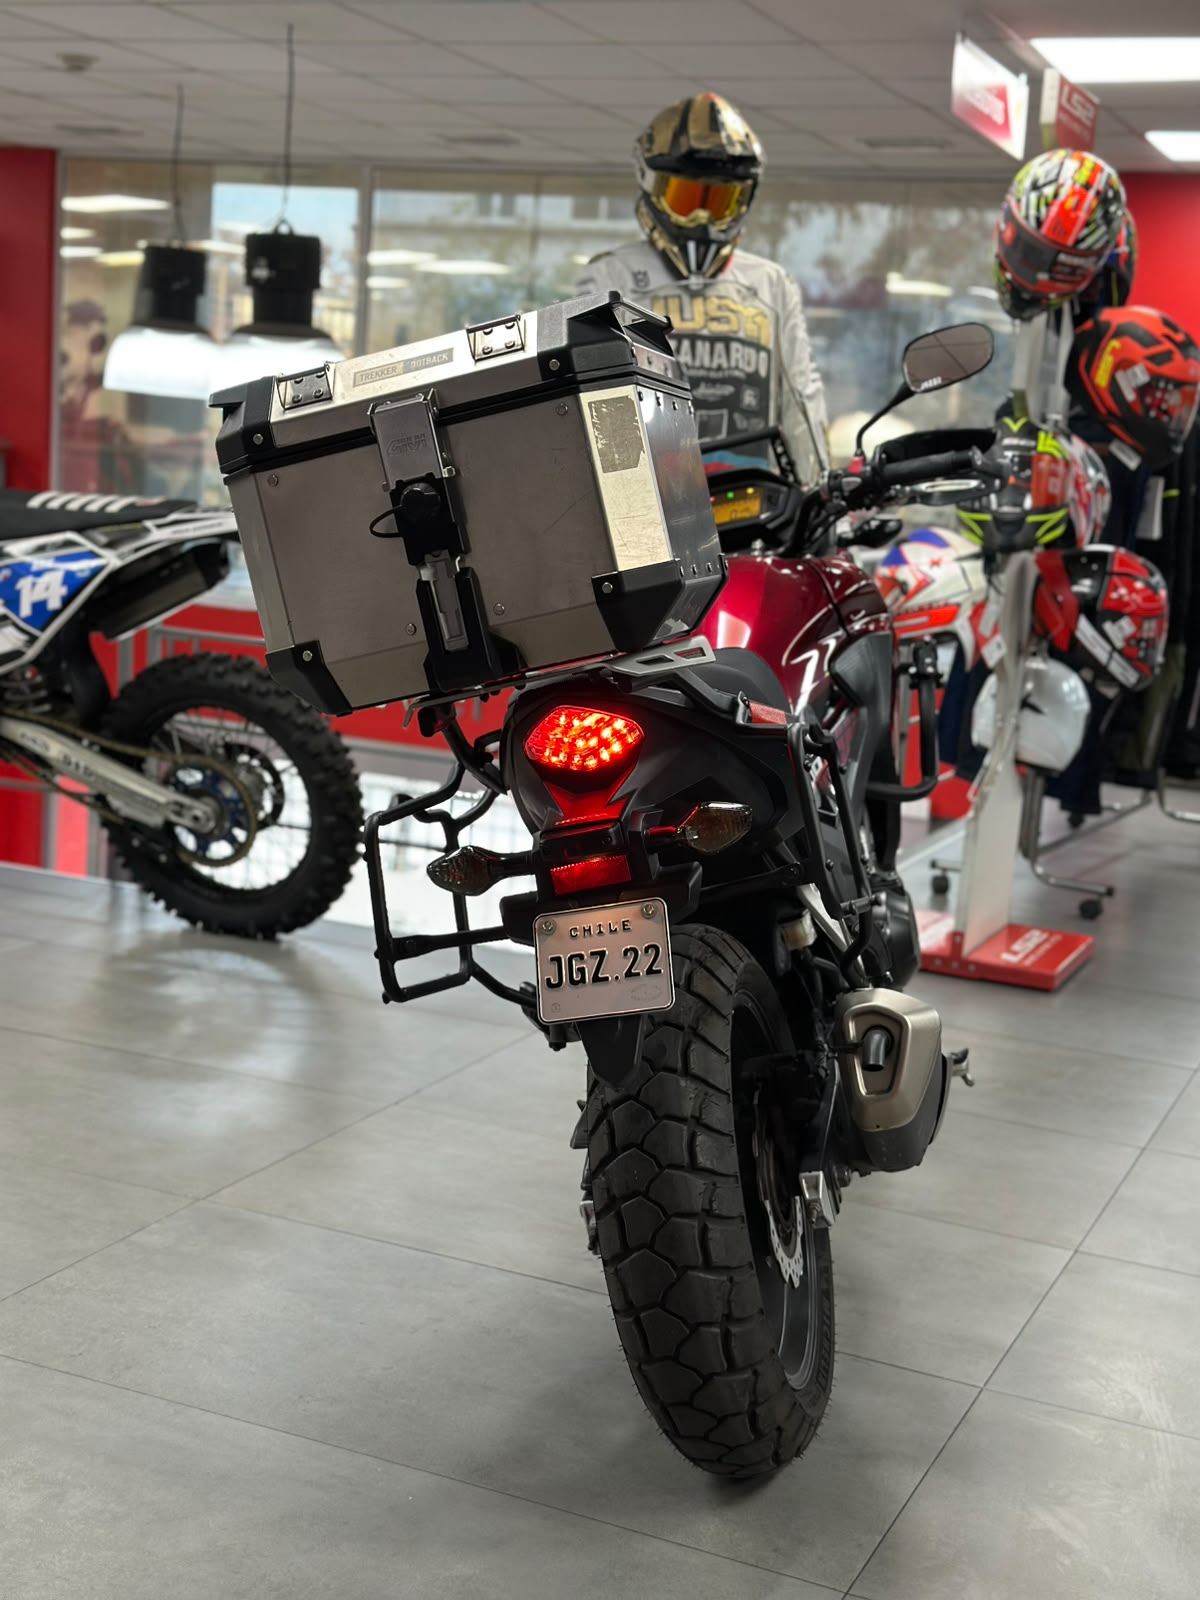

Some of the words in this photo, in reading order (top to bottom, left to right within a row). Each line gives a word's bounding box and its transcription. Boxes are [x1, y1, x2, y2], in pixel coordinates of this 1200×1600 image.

[360, 365, 398, 382] TREKKER
[387, 433, 428, 456] GIVI
[15, 569, 68, 618] 14
[569, 919, 632, 938] CHILE
[545, 943, 663, 989] JGZ.22
